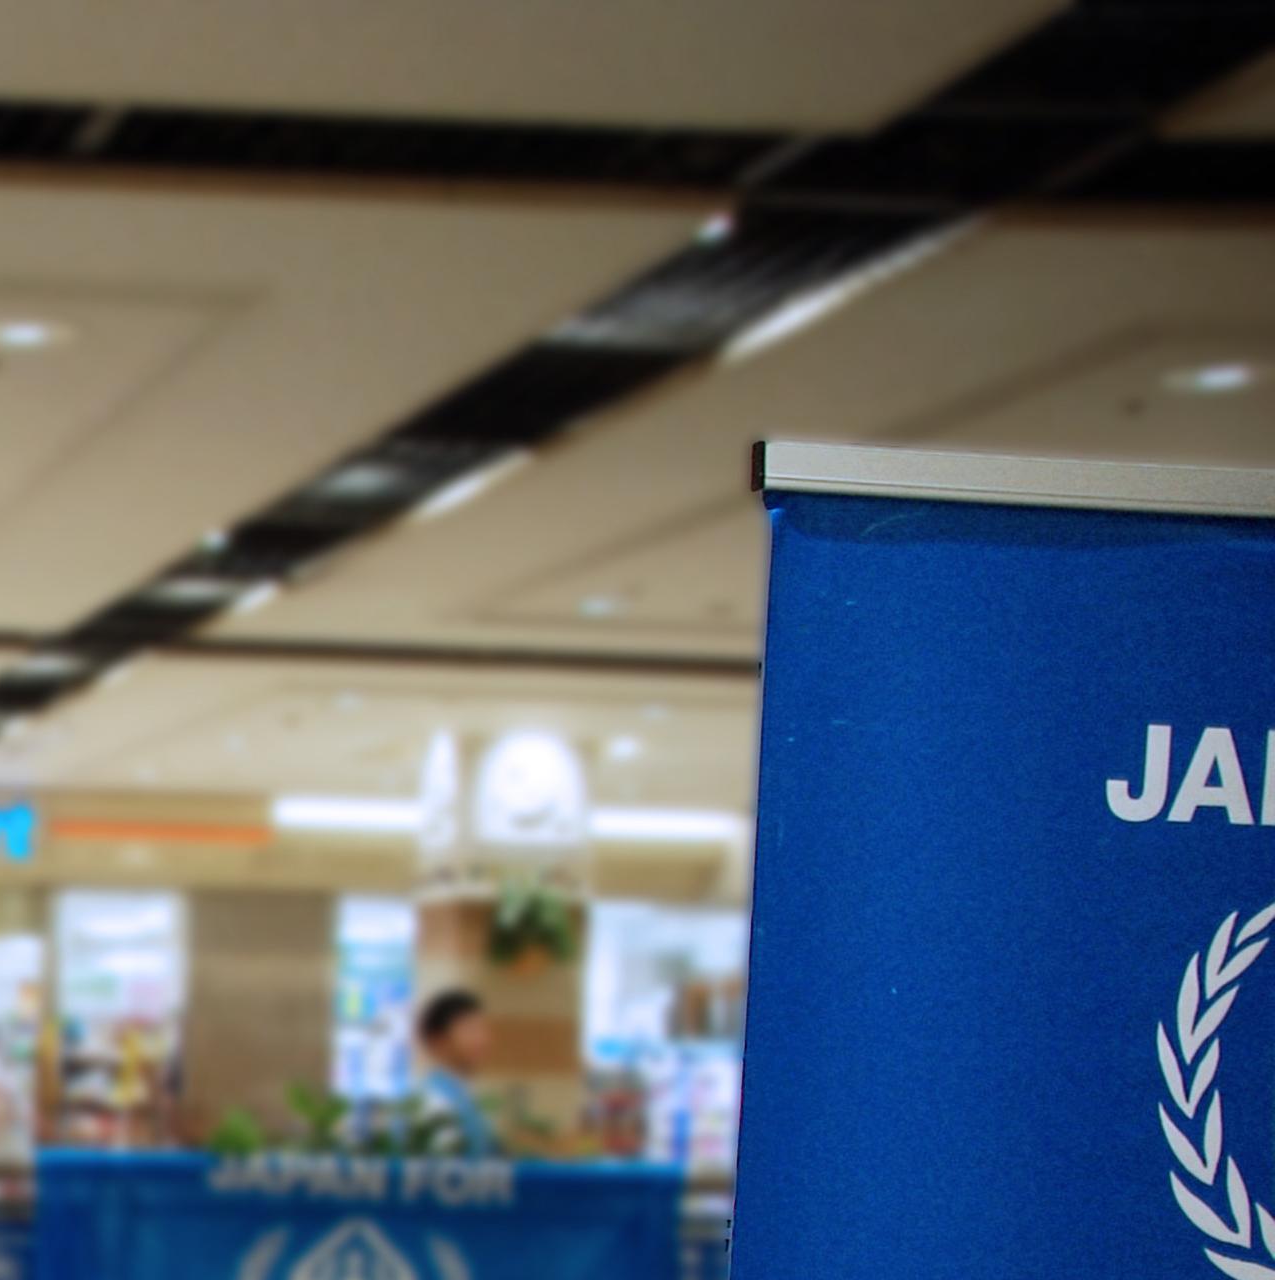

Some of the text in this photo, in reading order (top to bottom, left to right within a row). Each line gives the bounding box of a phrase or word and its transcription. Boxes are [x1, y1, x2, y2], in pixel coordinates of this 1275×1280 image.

[1106, 724, 1275, 825] JA
[209, 1154, 514, 1206] JAPAN FOR
